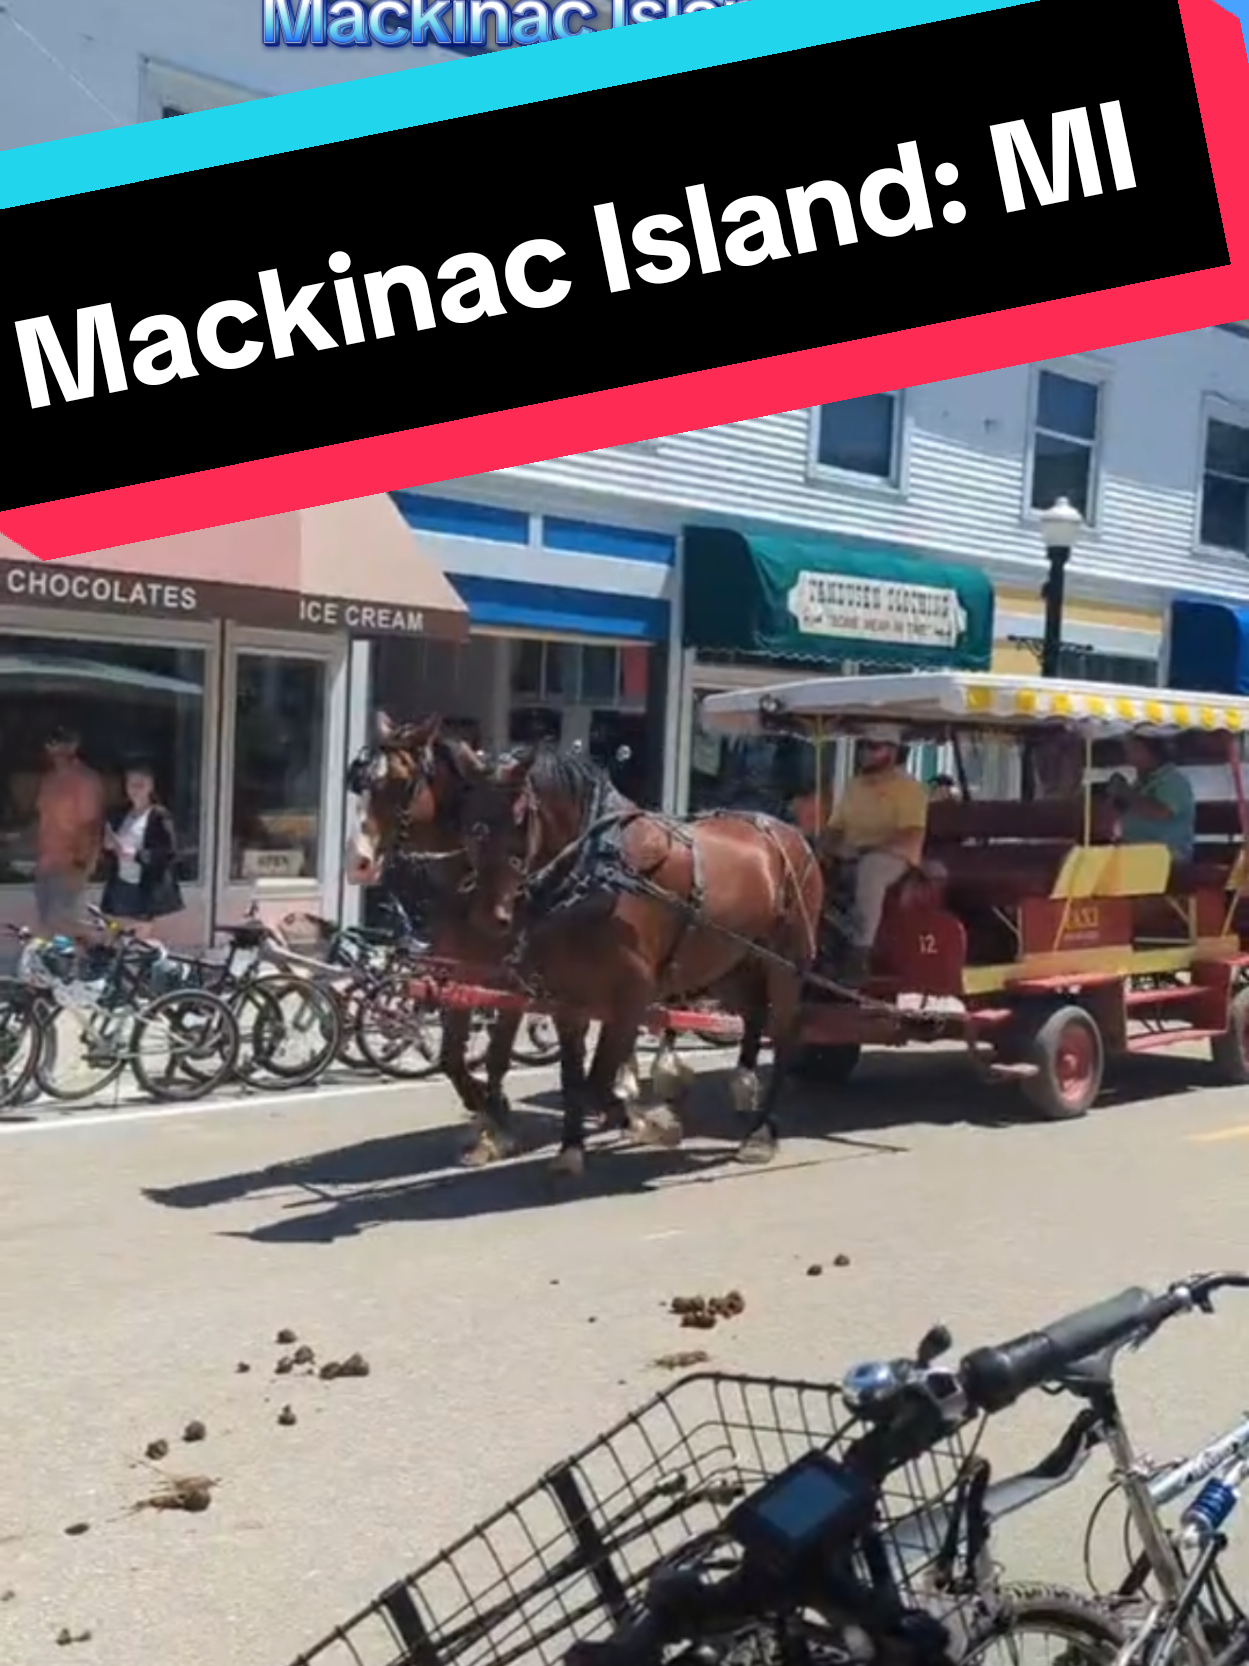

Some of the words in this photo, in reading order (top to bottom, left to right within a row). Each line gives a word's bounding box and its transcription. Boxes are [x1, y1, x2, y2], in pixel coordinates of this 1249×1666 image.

[7, 568, 197, 611] CHOCOLATES
[299, 599, 338, 625] ICE
[344, 604, 424, 632] CREAM
[919, 934, 938, 953] 12
